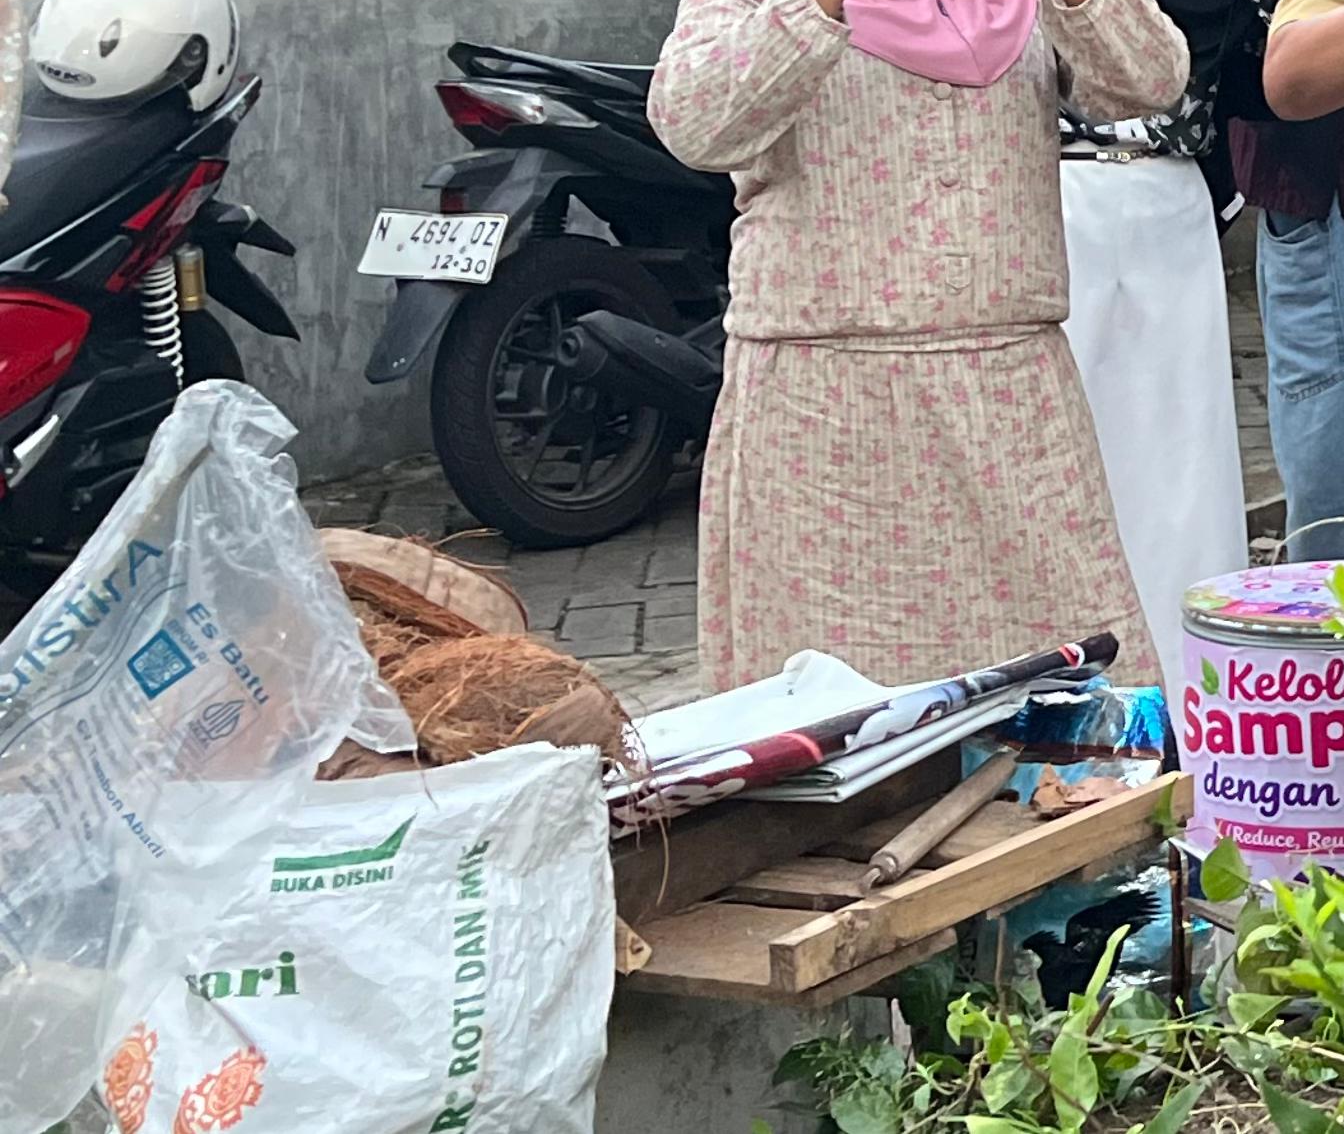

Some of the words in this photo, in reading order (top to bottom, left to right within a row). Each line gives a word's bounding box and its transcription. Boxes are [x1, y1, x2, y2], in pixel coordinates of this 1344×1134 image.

[375, 216, 392, 241] N
[410, 219, 464, 245] 4694
[186, 602, 219, 640] Es
[220, 642, 270, 705] Batu
[1204, 762, 1340, 817] dengan
[270, 875, 325, 893] BUKA
[332, 866, 394, 890] DISINI
[454, 908, 487, 984] DAN
[448, 992, 485, 1078] ROTI
